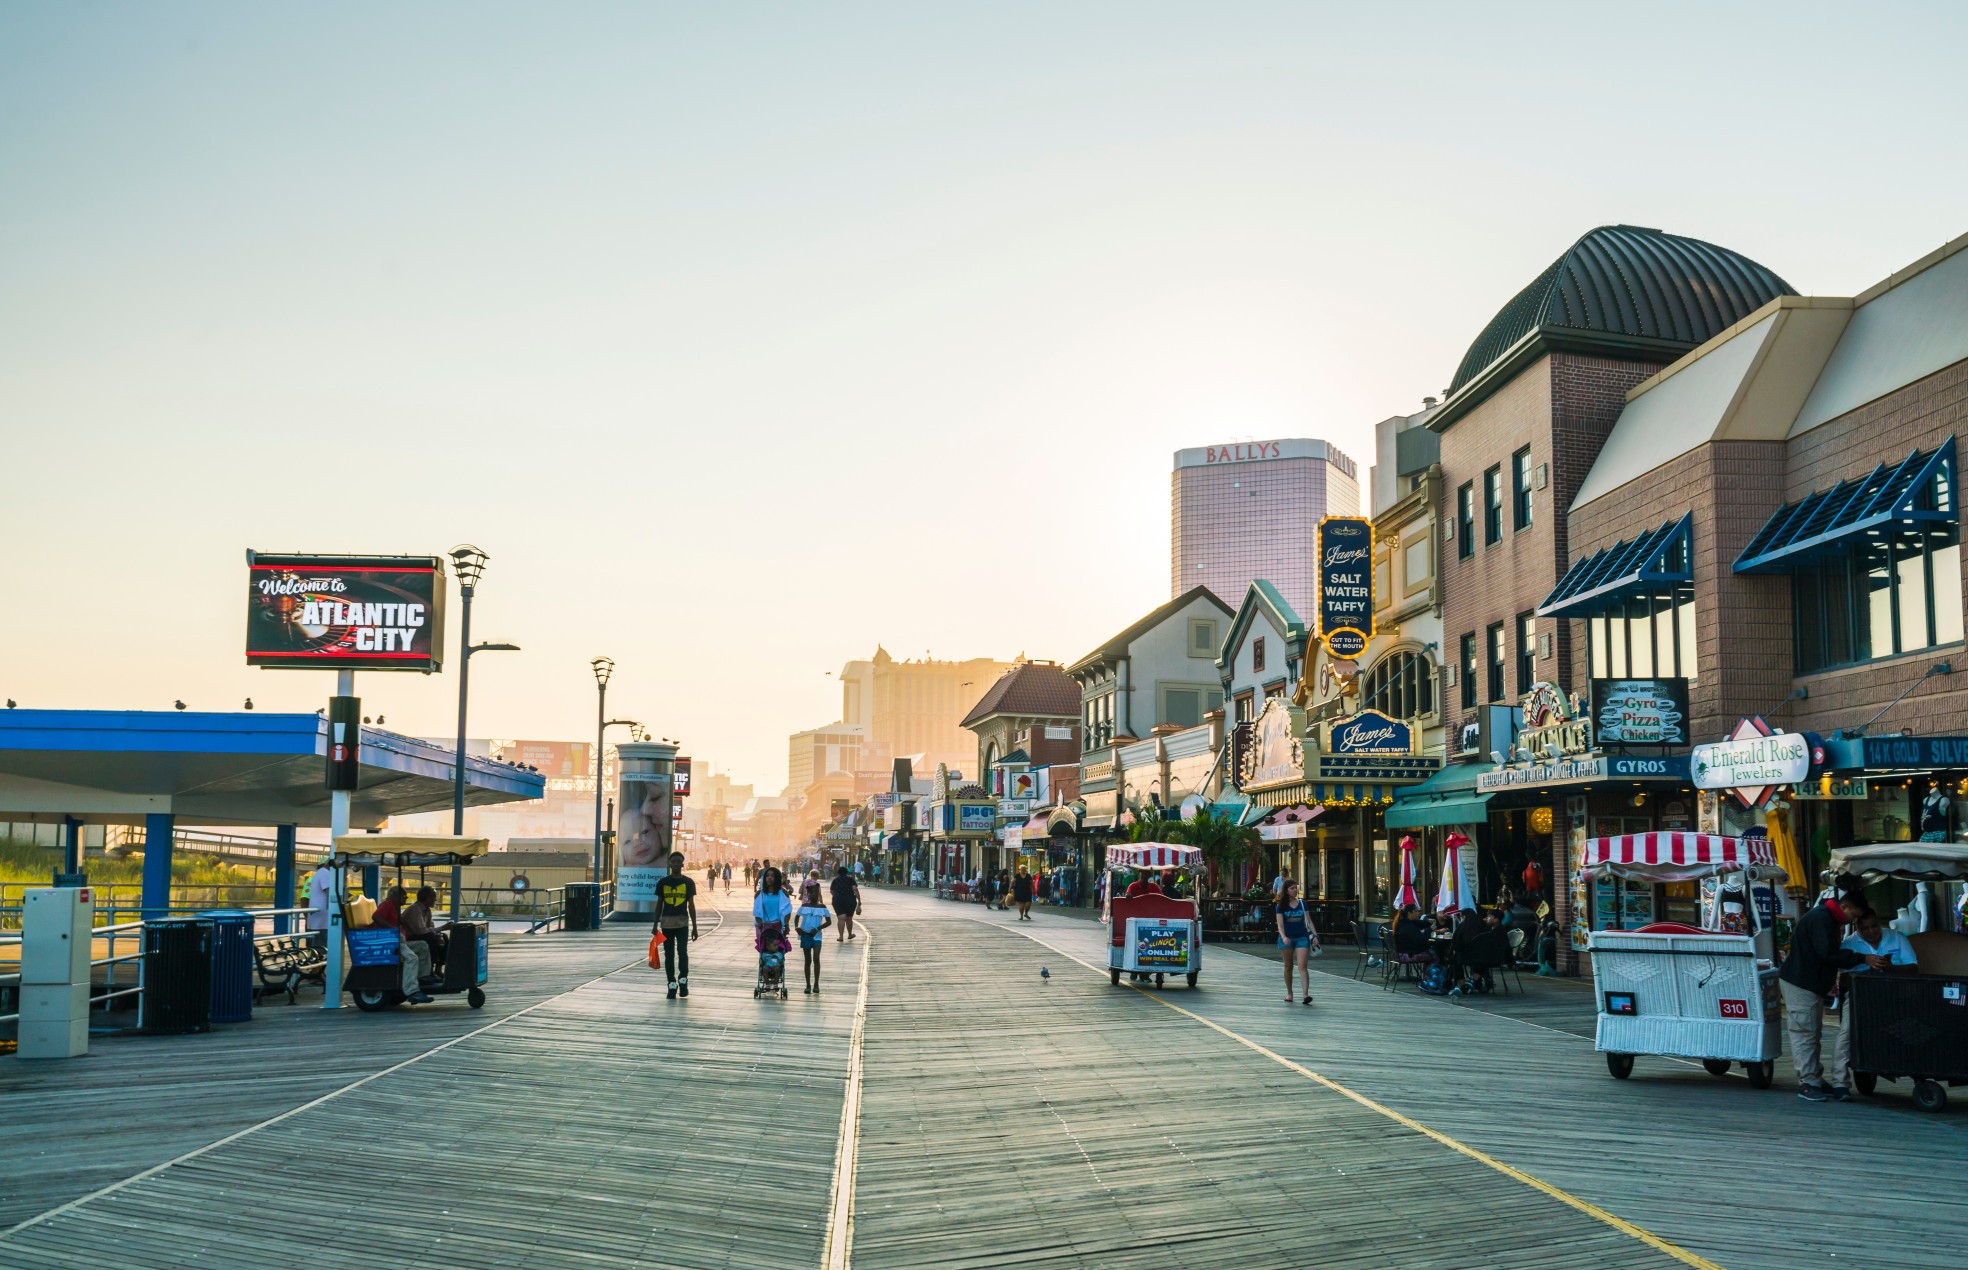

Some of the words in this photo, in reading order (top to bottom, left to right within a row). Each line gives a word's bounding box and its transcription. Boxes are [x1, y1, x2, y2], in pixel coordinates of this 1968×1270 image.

[1206, 442, 1280, 463] BALLYS
[258, 579, 329, 595] Welcome
[330, 577, 347, 592] to
[1330, 573, 1362, 584] SALT
[1325, 586, 1369, 597] WATER
[1327, 601, 1366, 612] TAFFY
[302, 602, 425, 627] ATLANTIC
[355, 627, 417, 651] CITY
[1625, 697, 1657, 712] Gyro
[1621, 713, 1660, 726] Pizza
[1621, 729, 1660, 740] Chicken
[1711, 741, 1765, 768] Emerald
[1770, 739, 1803, 762] Rose
[1893, 741, 1920, 763] GOLD
[1616, 760, 1667, 773] GYROS
[1730, 766, 1783, 784] Jewelers
[1829, 782, 1866, 797] Gold
[1148, 938, 1177, 948] SLINGO
[1723, 1003, 1745, 1014] 310
